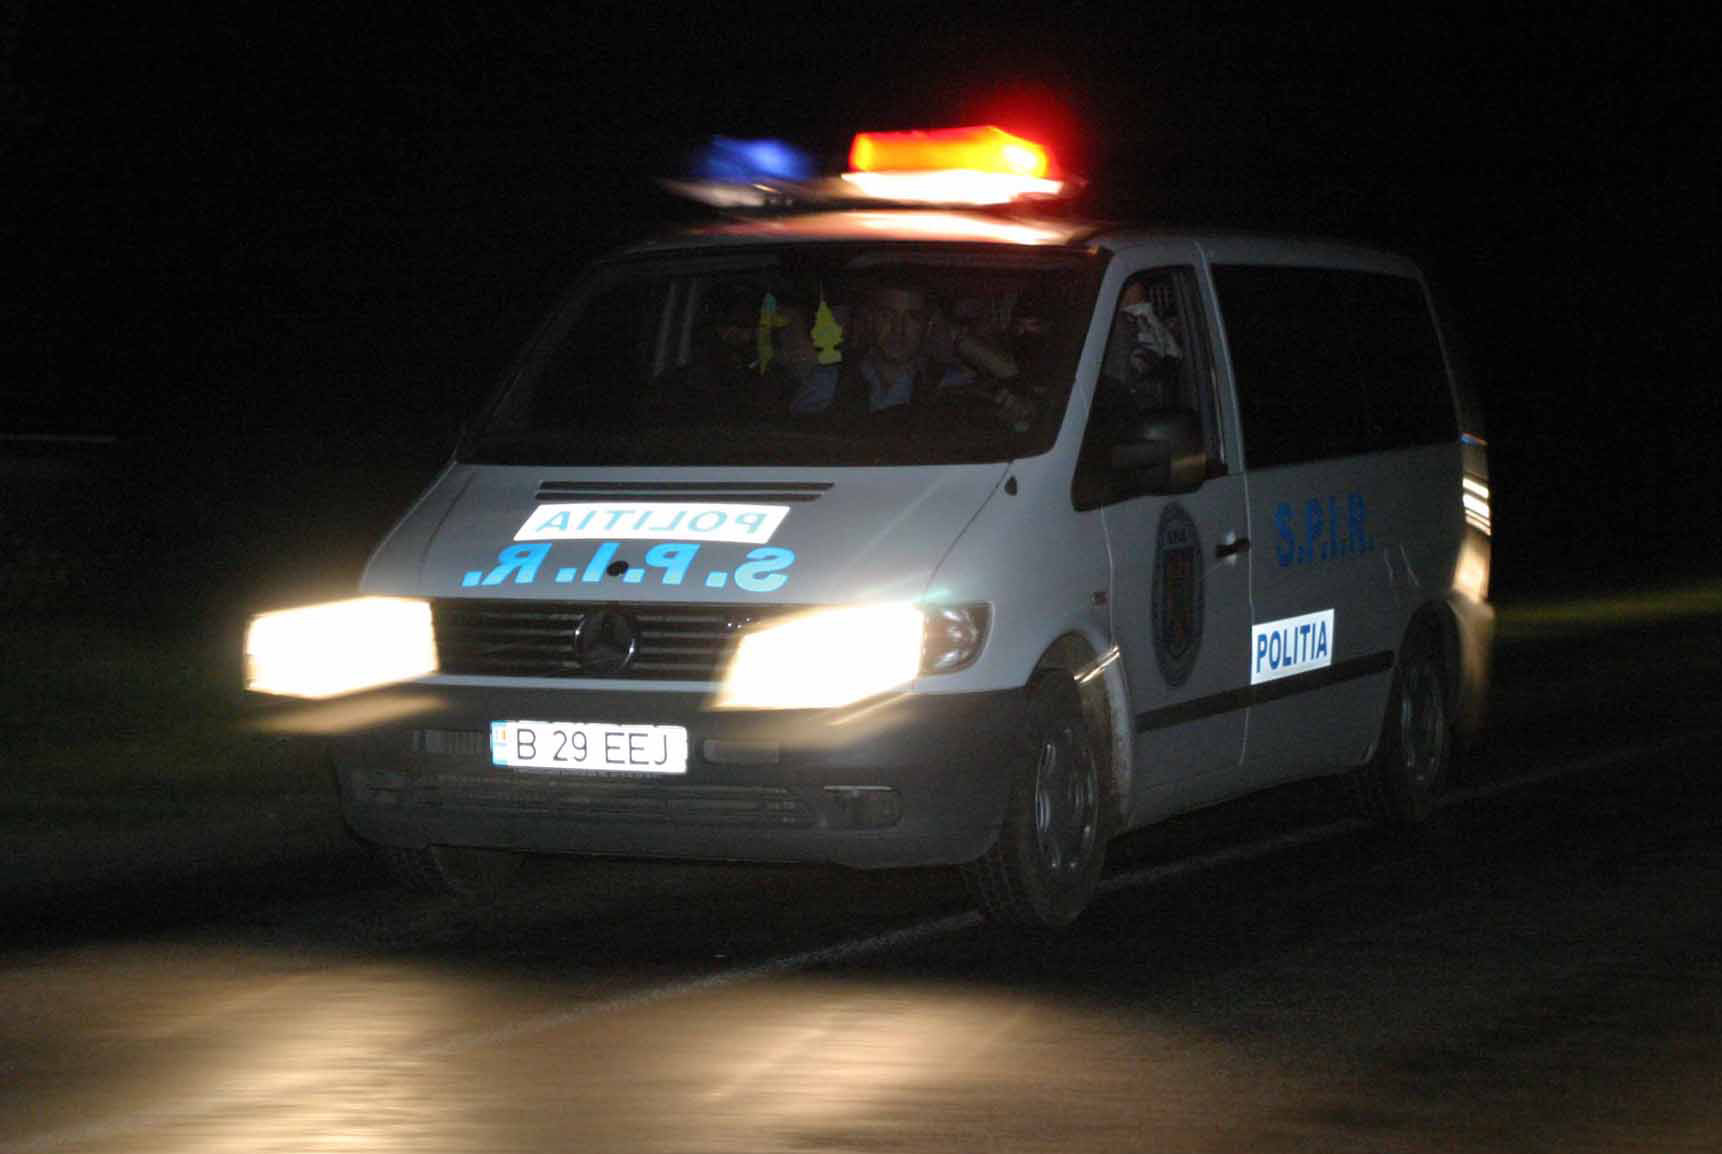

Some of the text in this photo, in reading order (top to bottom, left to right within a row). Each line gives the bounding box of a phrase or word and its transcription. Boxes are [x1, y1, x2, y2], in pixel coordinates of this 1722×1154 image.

[1274, 493, 1375, 567] S.P.I.R.
[1256, 620, 1328, 673] POLITIA
[516, 728, 668, 766] B 29 EEJ
